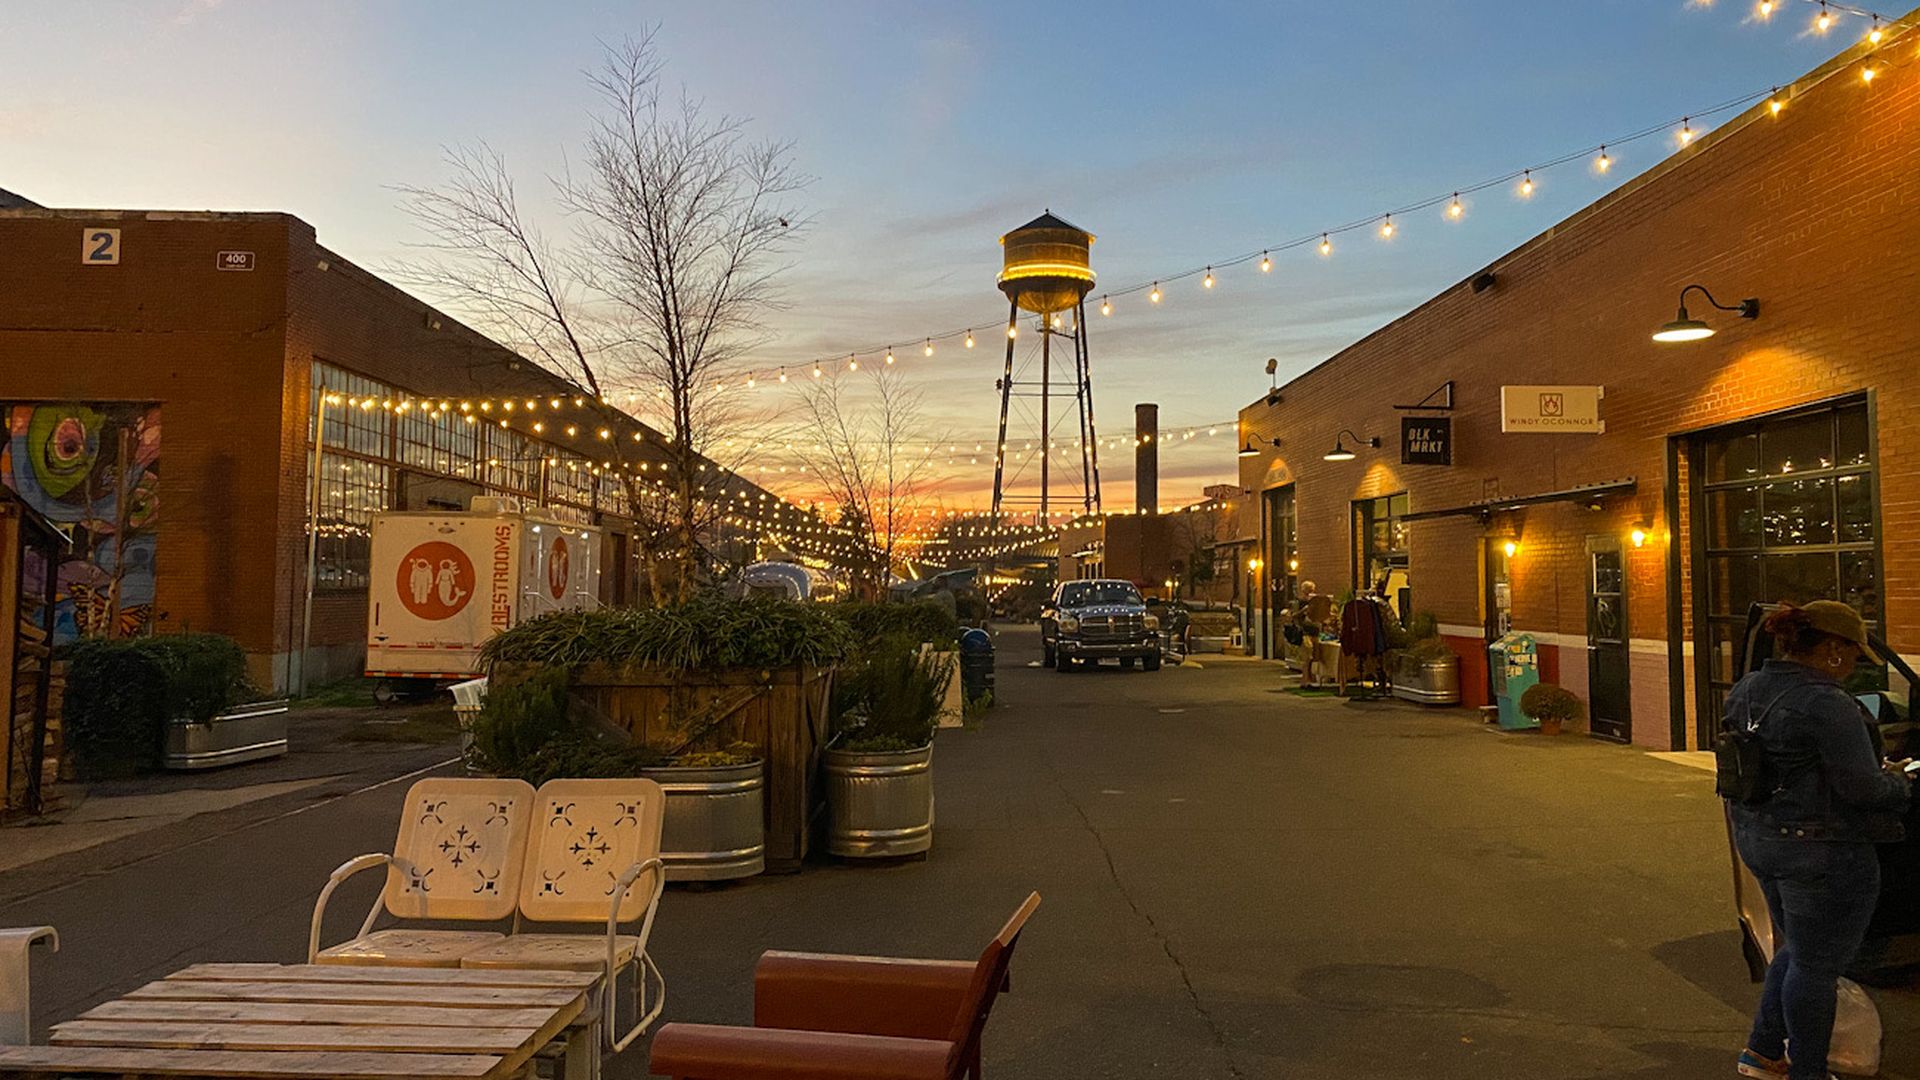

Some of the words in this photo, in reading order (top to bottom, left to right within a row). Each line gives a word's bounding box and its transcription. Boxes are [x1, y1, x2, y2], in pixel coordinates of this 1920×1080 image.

[90, 232, 113, 261] 2
[226, 254, 246, 263] 400
[1410, 440, 1443, 453] MRKT
[491, 525, 511, 626] RESTROOMS
